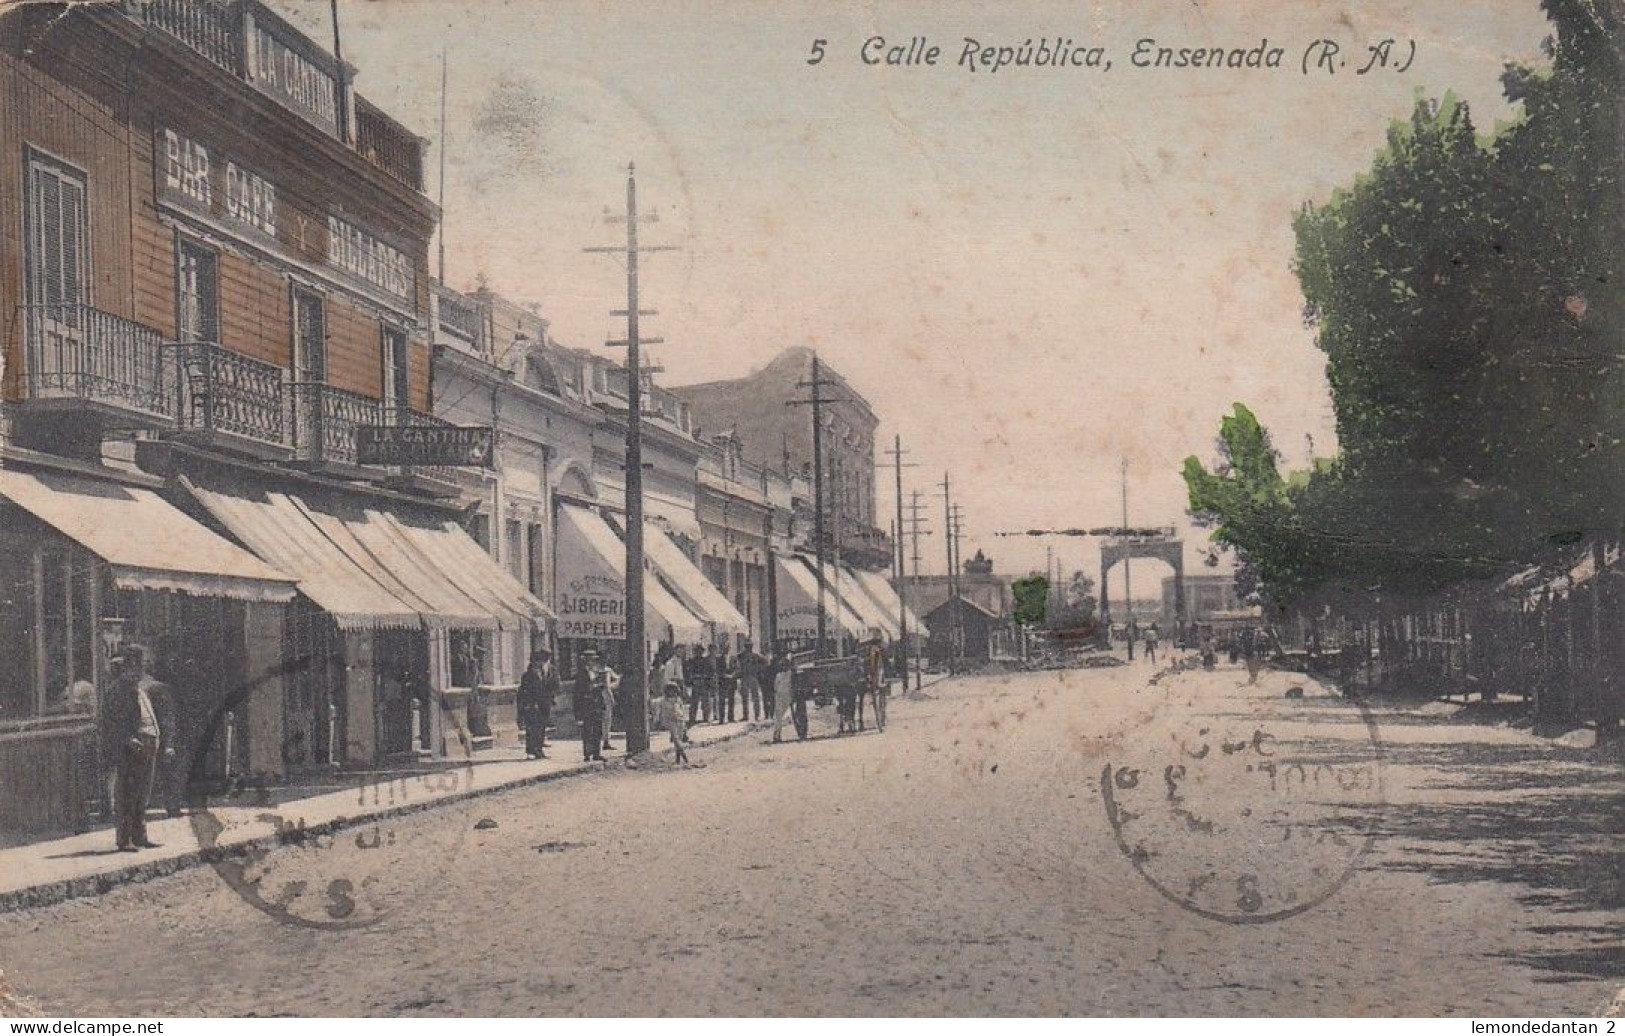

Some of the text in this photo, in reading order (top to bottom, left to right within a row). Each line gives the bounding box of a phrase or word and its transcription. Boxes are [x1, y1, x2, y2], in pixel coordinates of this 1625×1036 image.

[258, 28, 278, 88] LA
[165, 128, 212, 206] BAR
[226, 161, 275, 236] CAFE
[373, 429, 480, 444] LA CANTINA
[561, 593, 624, 615] LIBRERI
